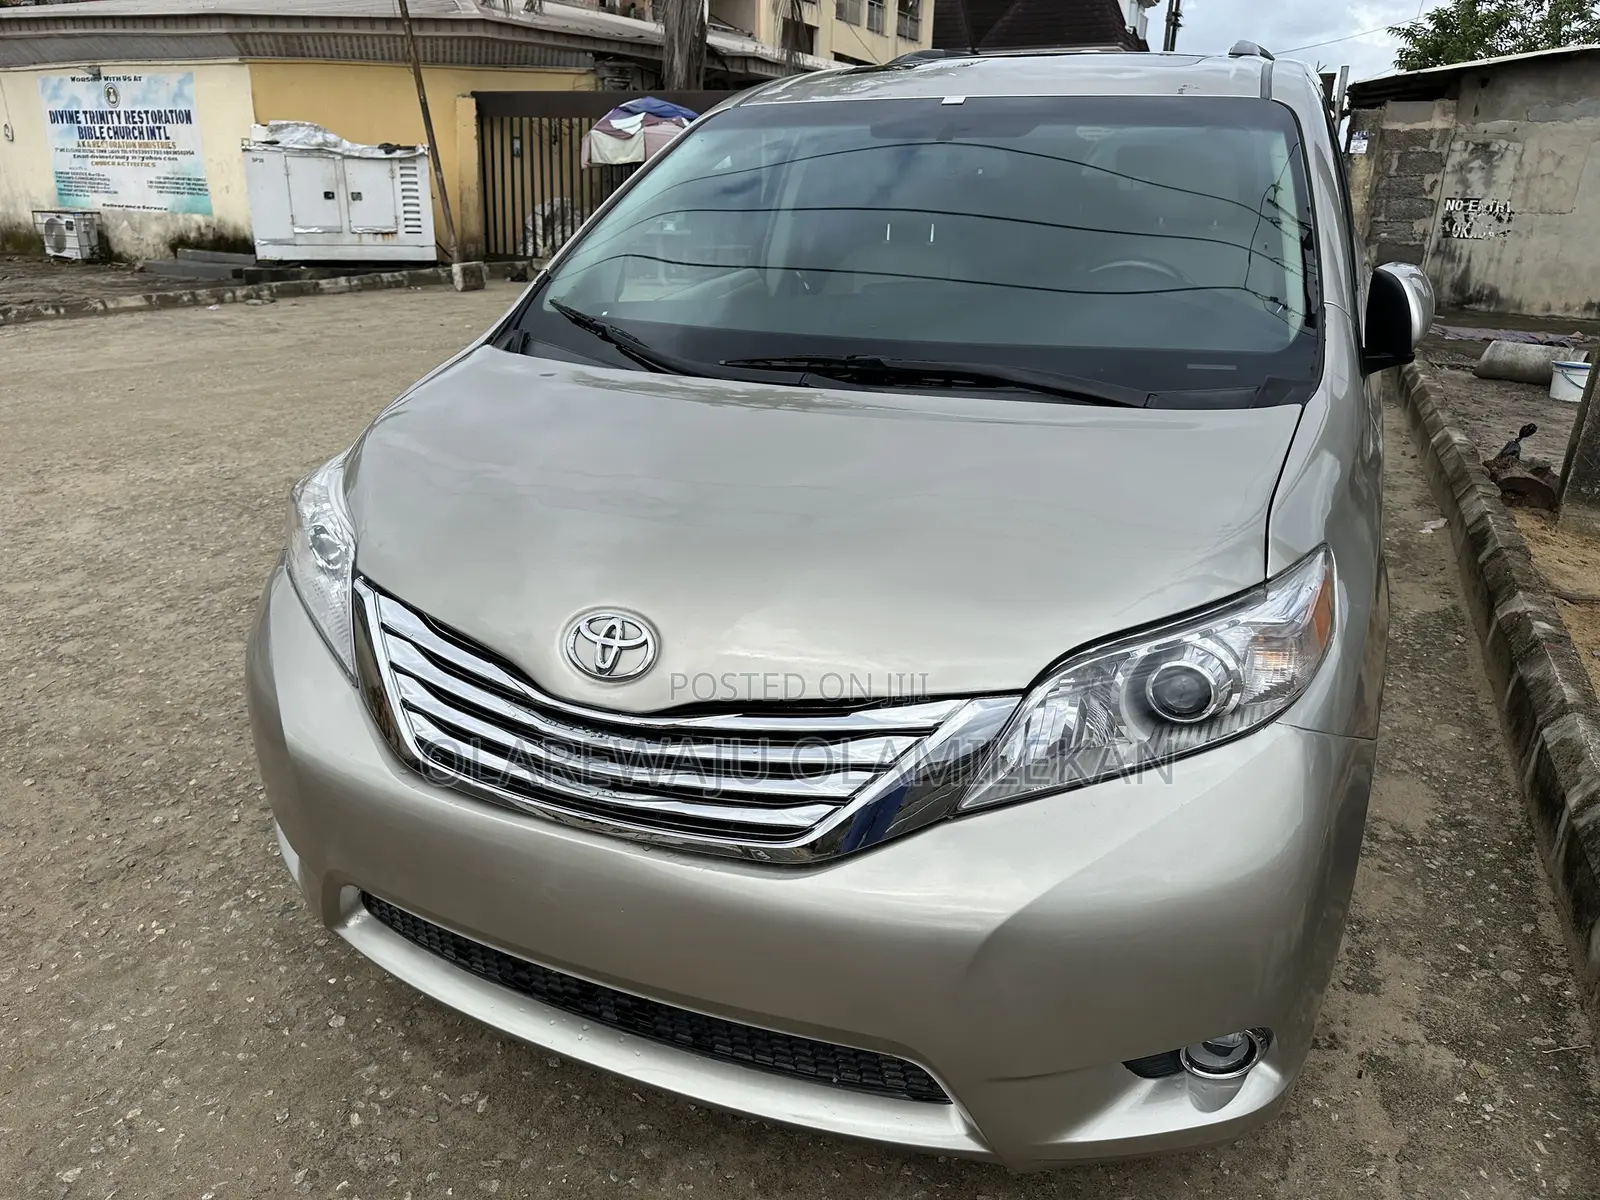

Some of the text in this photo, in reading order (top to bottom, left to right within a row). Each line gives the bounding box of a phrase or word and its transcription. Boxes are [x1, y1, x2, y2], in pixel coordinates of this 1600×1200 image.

[49, 109, 192, 124] DIVINE TRINITY RESTORATION
[77, 126, 106, 140] BIBLE
[107, 126, 145, 140] CHURCH
